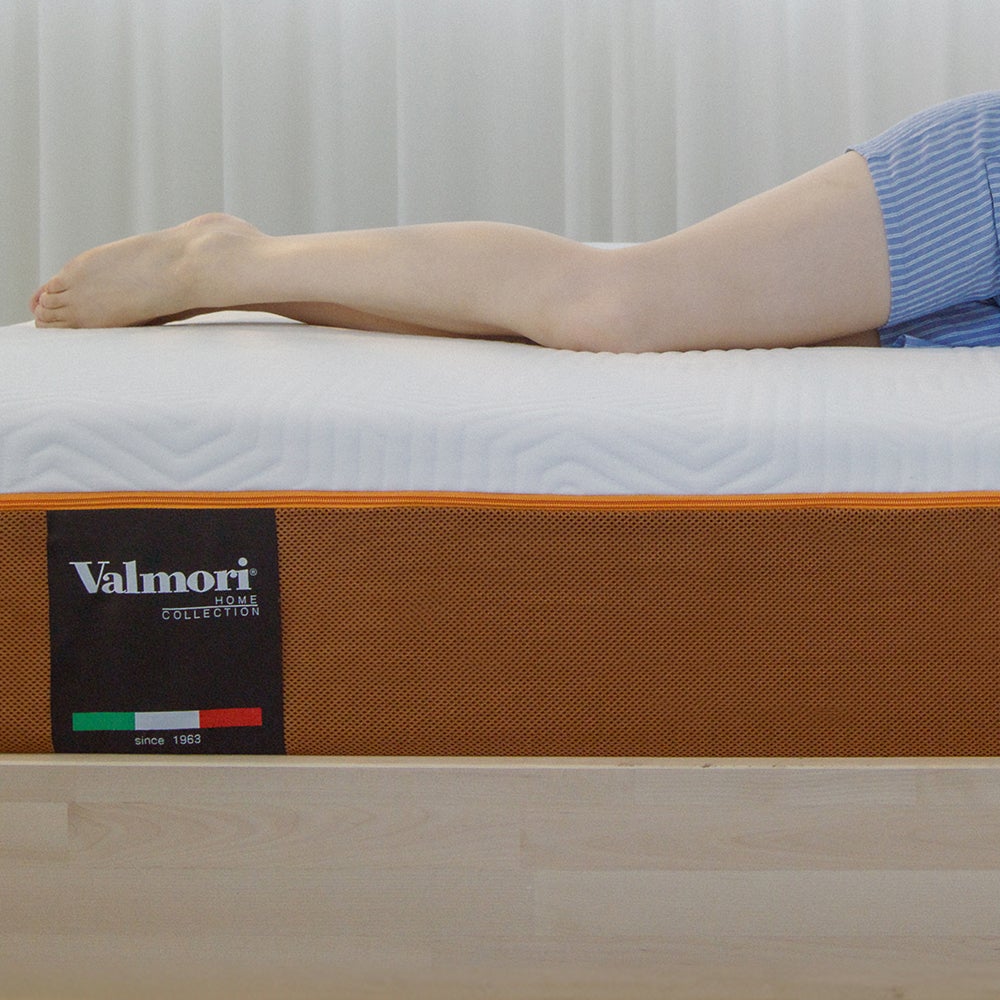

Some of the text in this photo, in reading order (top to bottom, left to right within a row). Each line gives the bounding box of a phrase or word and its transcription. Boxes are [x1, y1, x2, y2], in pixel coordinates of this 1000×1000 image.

[215, 594, 258, 605] HOME
[161, 606, 260, 621] COLLECTION
[134, 733, 202, 746] since 1963
